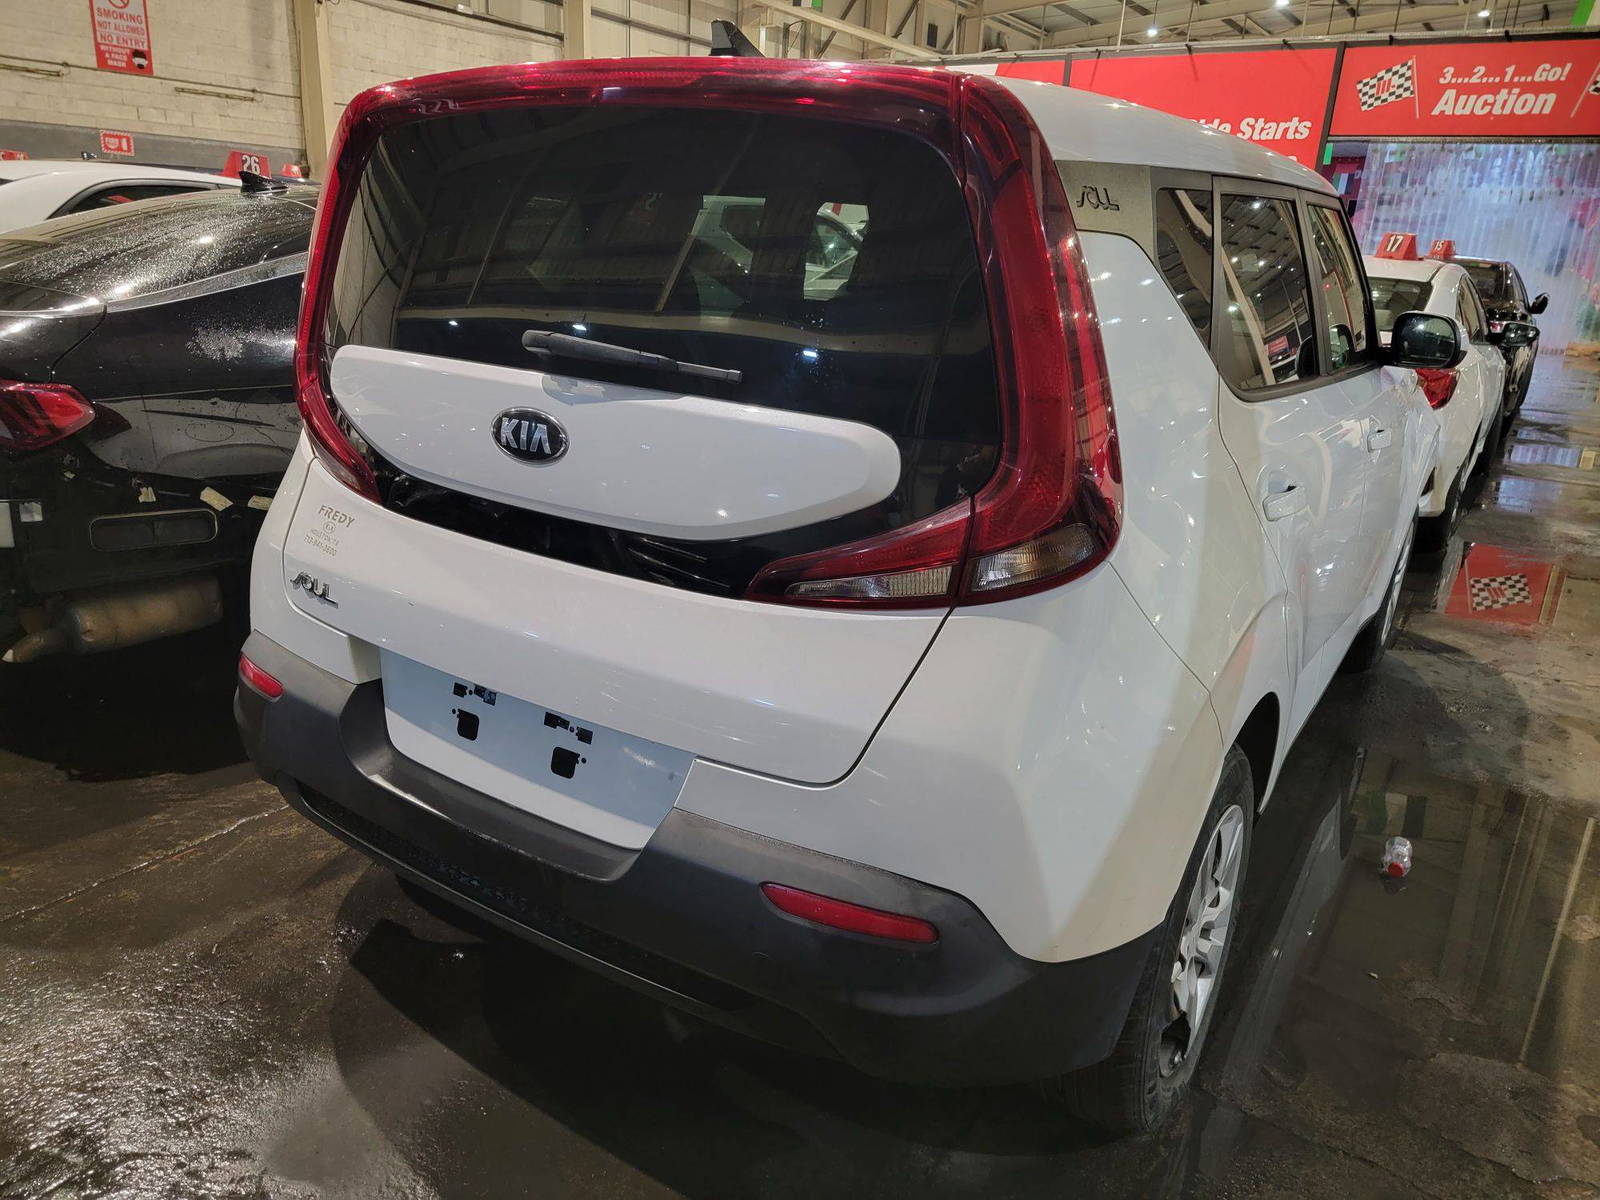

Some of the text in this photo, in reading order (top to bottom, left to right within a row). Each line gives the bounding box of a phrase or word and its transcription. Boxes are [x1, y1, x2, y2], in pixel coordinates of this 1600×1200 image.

[96, 8, 143, 24] SMOKING
[97, 21, 145, 35] NOT ALLOWED
[100, 33, 145, 48] NO ENTRY
[1431, 88, 1557, 116] Auction
[1236, 117, 1312, 140] Starts
[242, 155, 260, 175] 26
[1386, 234, 1404, 252] 17
[501, 417, 552, 455] KIA
[318, 504, 356, 528] FREDY
